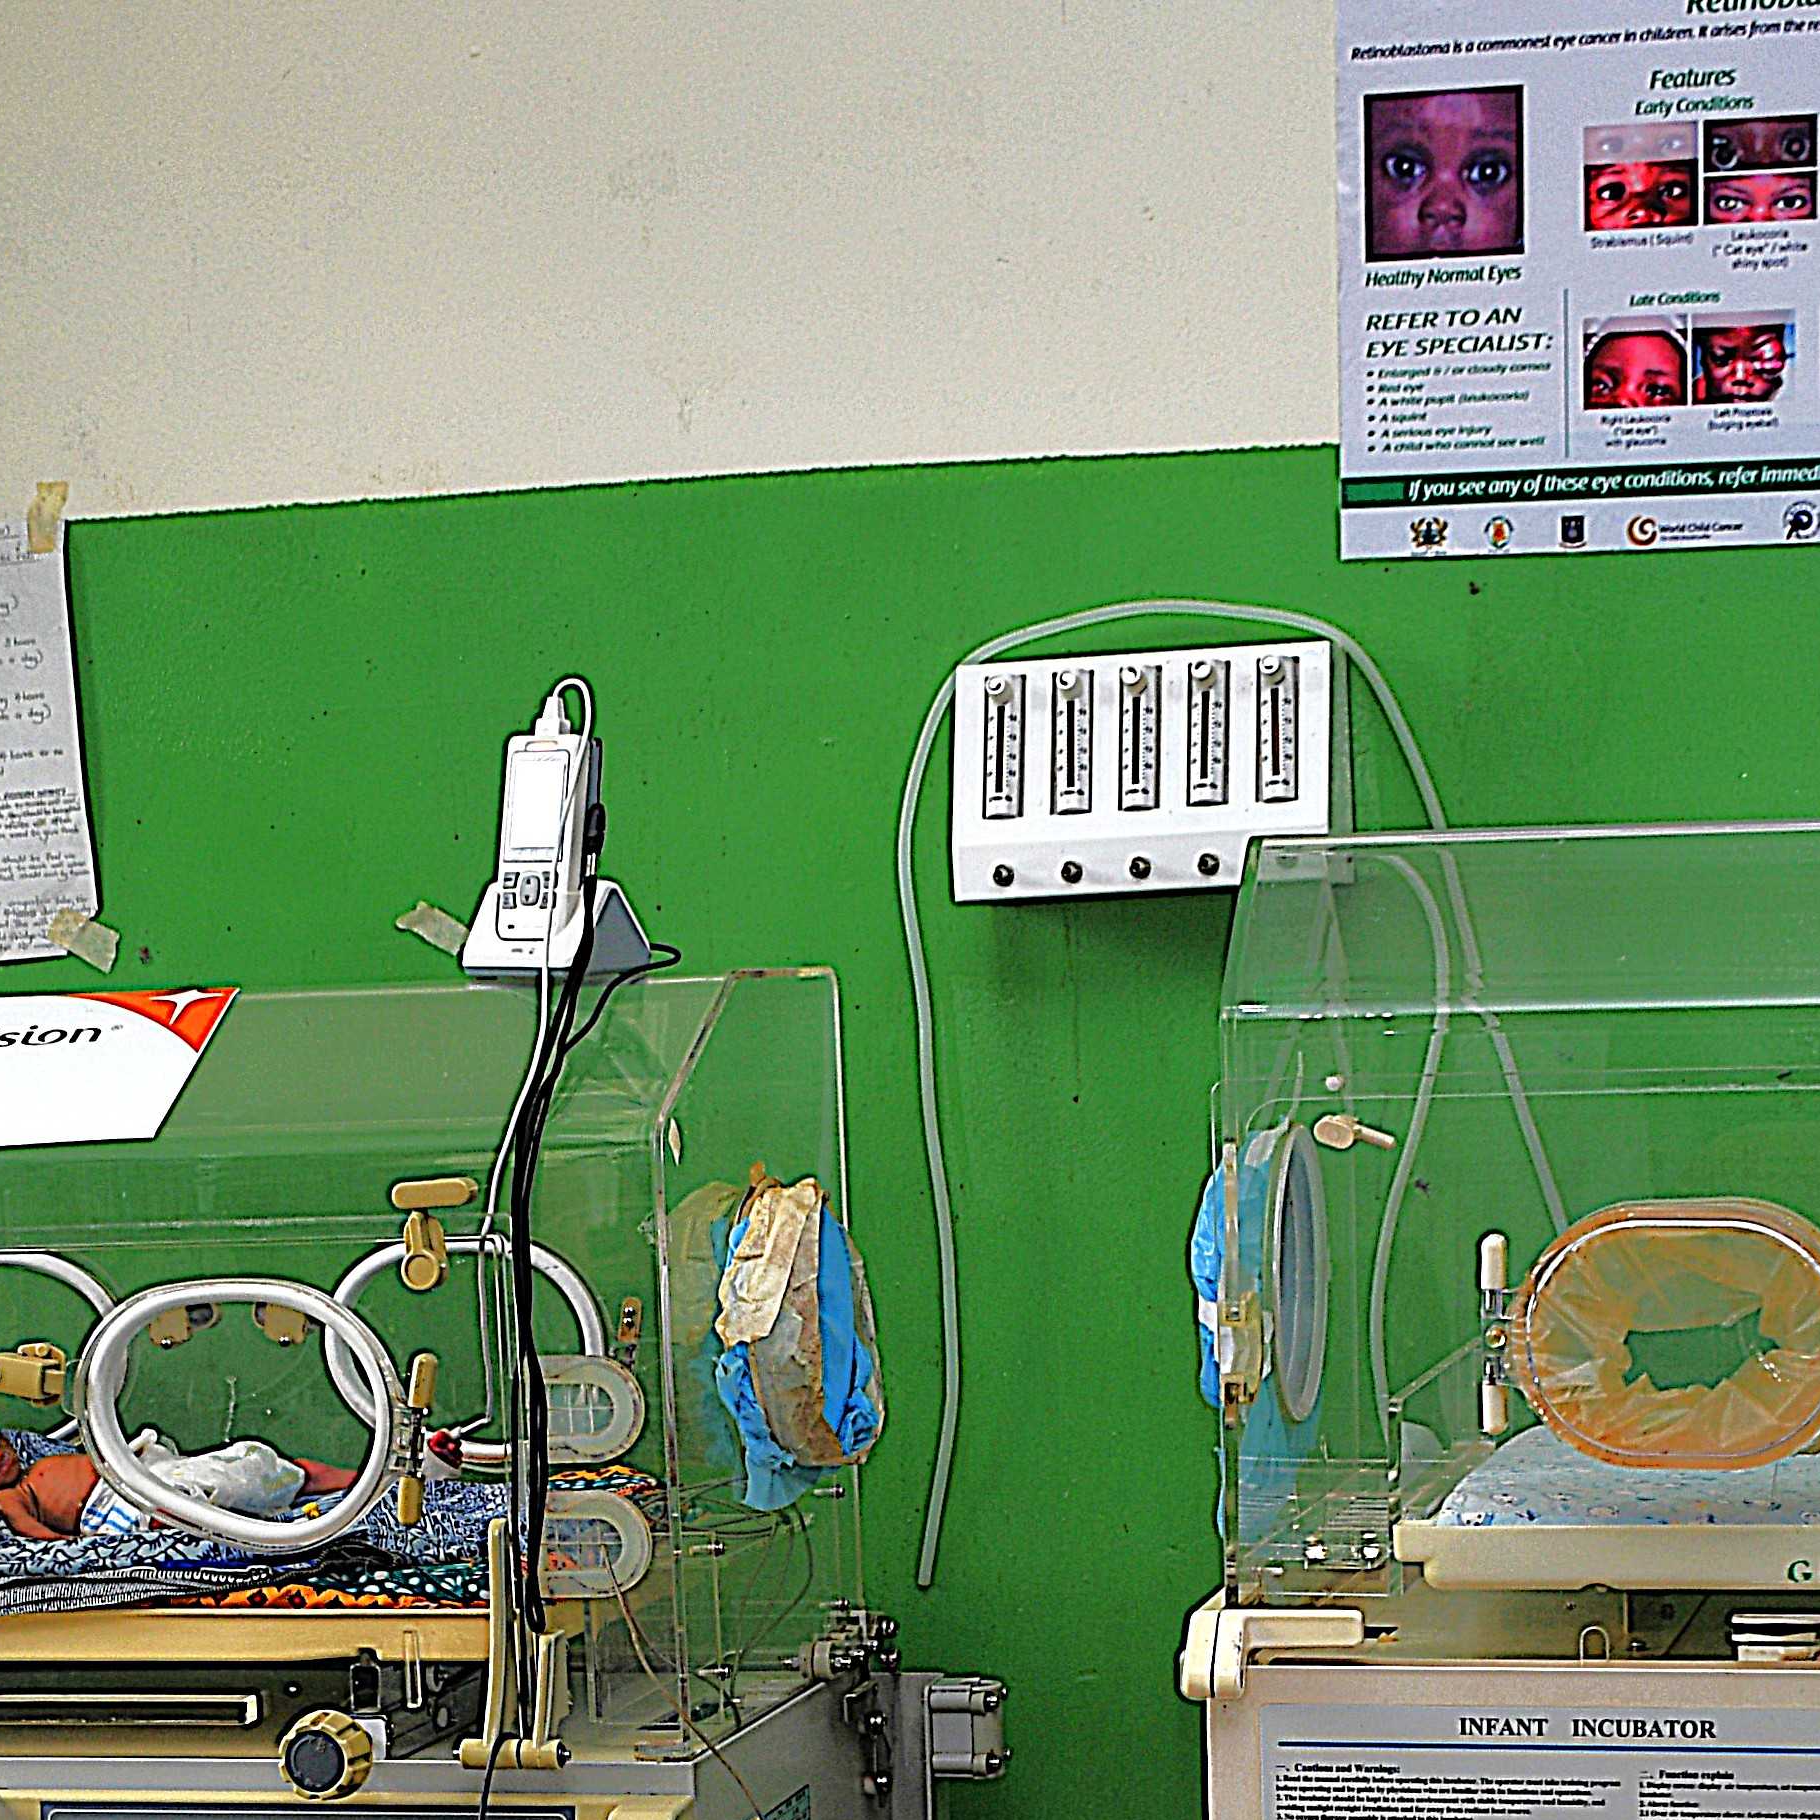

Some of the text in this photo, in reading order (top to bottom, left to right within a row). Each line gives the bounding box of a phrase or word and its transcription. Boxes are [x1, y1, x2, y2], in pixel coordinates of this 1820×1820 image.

[1350, 43, 1450, 60] Retinoblastoma
[1451, 40, 1463, 54] is
[1464, 41, 1474, 53] a
[1476, 35, 1551, 52] commonest
[1552, 35, 1576, 51] eye
[1578, 33, 1622, 45] cancer
[1622, 30, 1637, 42] in
[1710, 23, 1747, 37] arises
[1746, 20, 1781, 39] from
[1782, 20, 1806, 33] the
[1648, 69, 1736, 90] Features
[1634, 96, 1754, 118] Early Conditions
[1364, 265, 1522, 289] Healthy Normal Eyes
[1628, 292, 1720, 307] Late Conditions
[1365, 307, 1522, 331] REFER TO AN
[1365, 333, 1554, 358] EYE SPECIALIST:
[1408, 479, 1422, 502] If
[1422, 483, 1454, 501] you
[1457, 481, 1486, 496] see
[1487, 480, 1520, 498] any
[1522, 474, 1543, 496] of
[1544, 476, 1588, 491] these
[1590, 475, 1622, 494] eye
[1623, 470, 1714, 488] conditions,
[1717, 466, 1759, 488] refer
[1458, 1717, 1717, 1739] INFANT INCUBATOR
